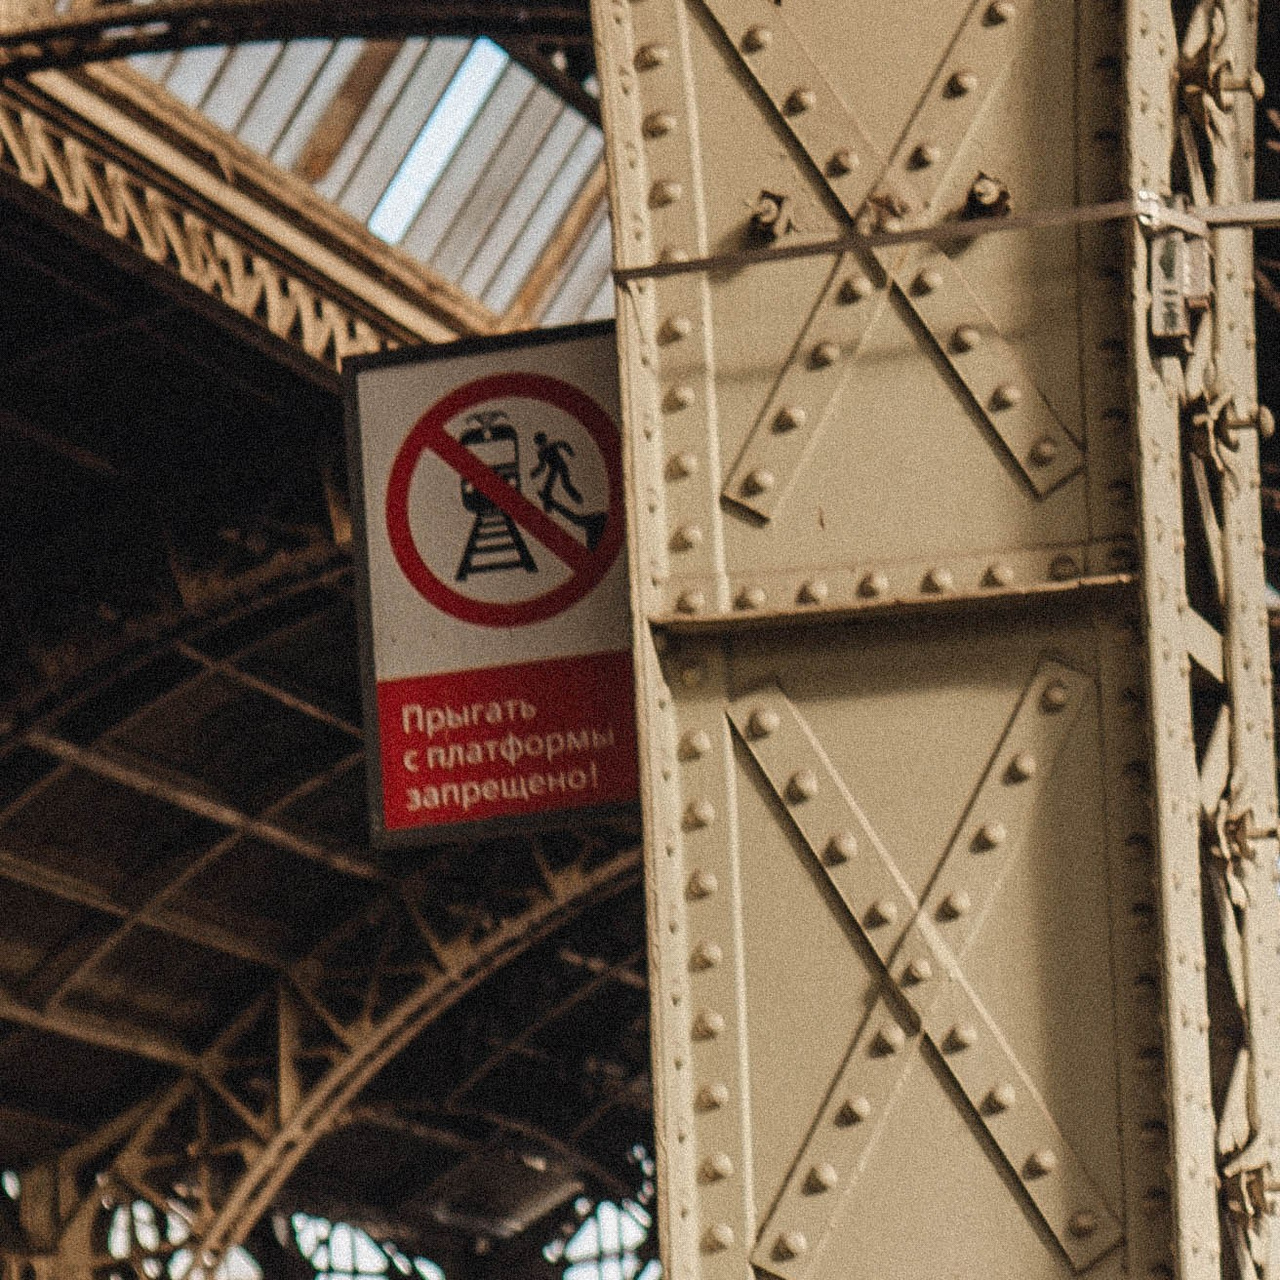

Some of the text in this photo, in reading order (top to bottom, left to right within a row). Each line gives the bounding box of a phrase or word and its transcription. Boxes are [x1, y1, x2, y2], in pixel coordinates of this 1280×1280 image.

[402, 699, 537, 739] Прыгать
[403, 728, 615, 772] с платформы
[407, 761, 598, 813] запрещено!
